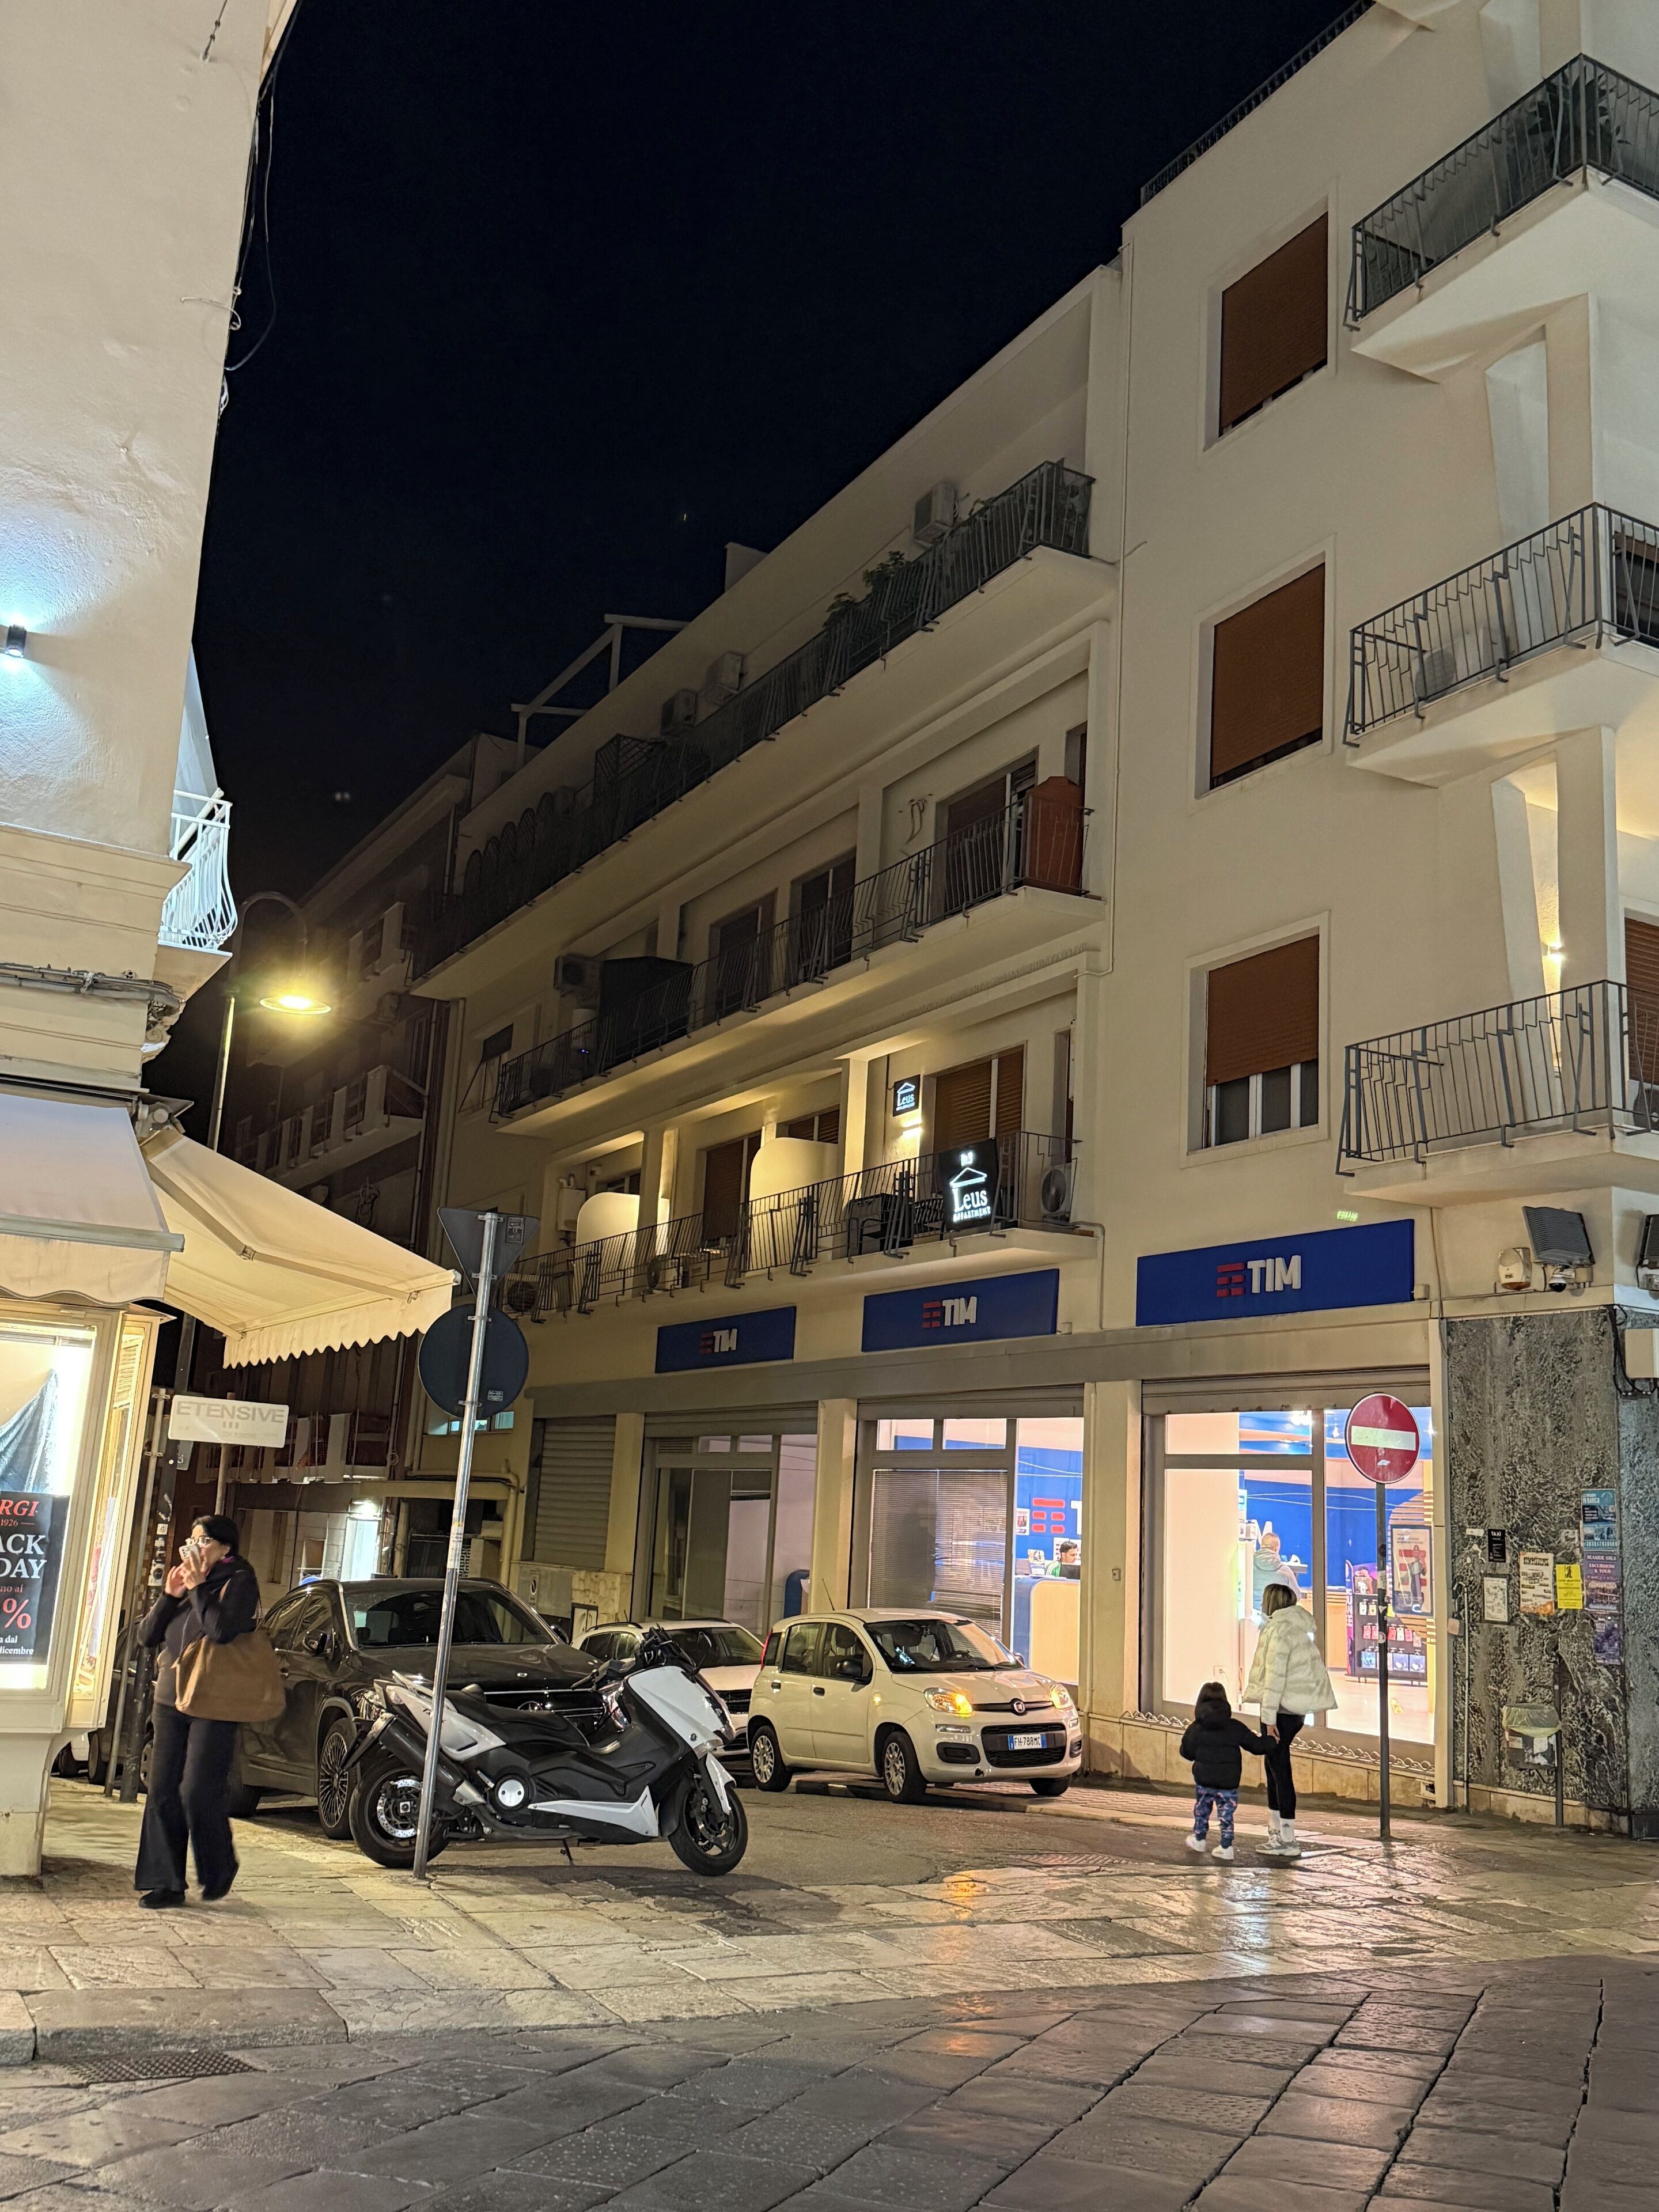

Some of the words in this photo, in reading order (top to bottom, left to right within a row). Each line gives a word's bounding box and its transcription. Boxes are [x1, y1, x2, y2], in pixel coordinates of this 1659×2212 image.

[952, 1188, 988, 1213] Leus
[1247, 1255, 1301, 1293] TIM
[942, 1296, 978, 1326] TIM
[713, 1328, 737, 1353] TIM
[176, 1400, 285, 1423] ETENSIVE
[0, 1499, 40, 1516] RGI
[1, 1518, 18, 1527] 1926
[5, 1635, 18, 1643] dal
